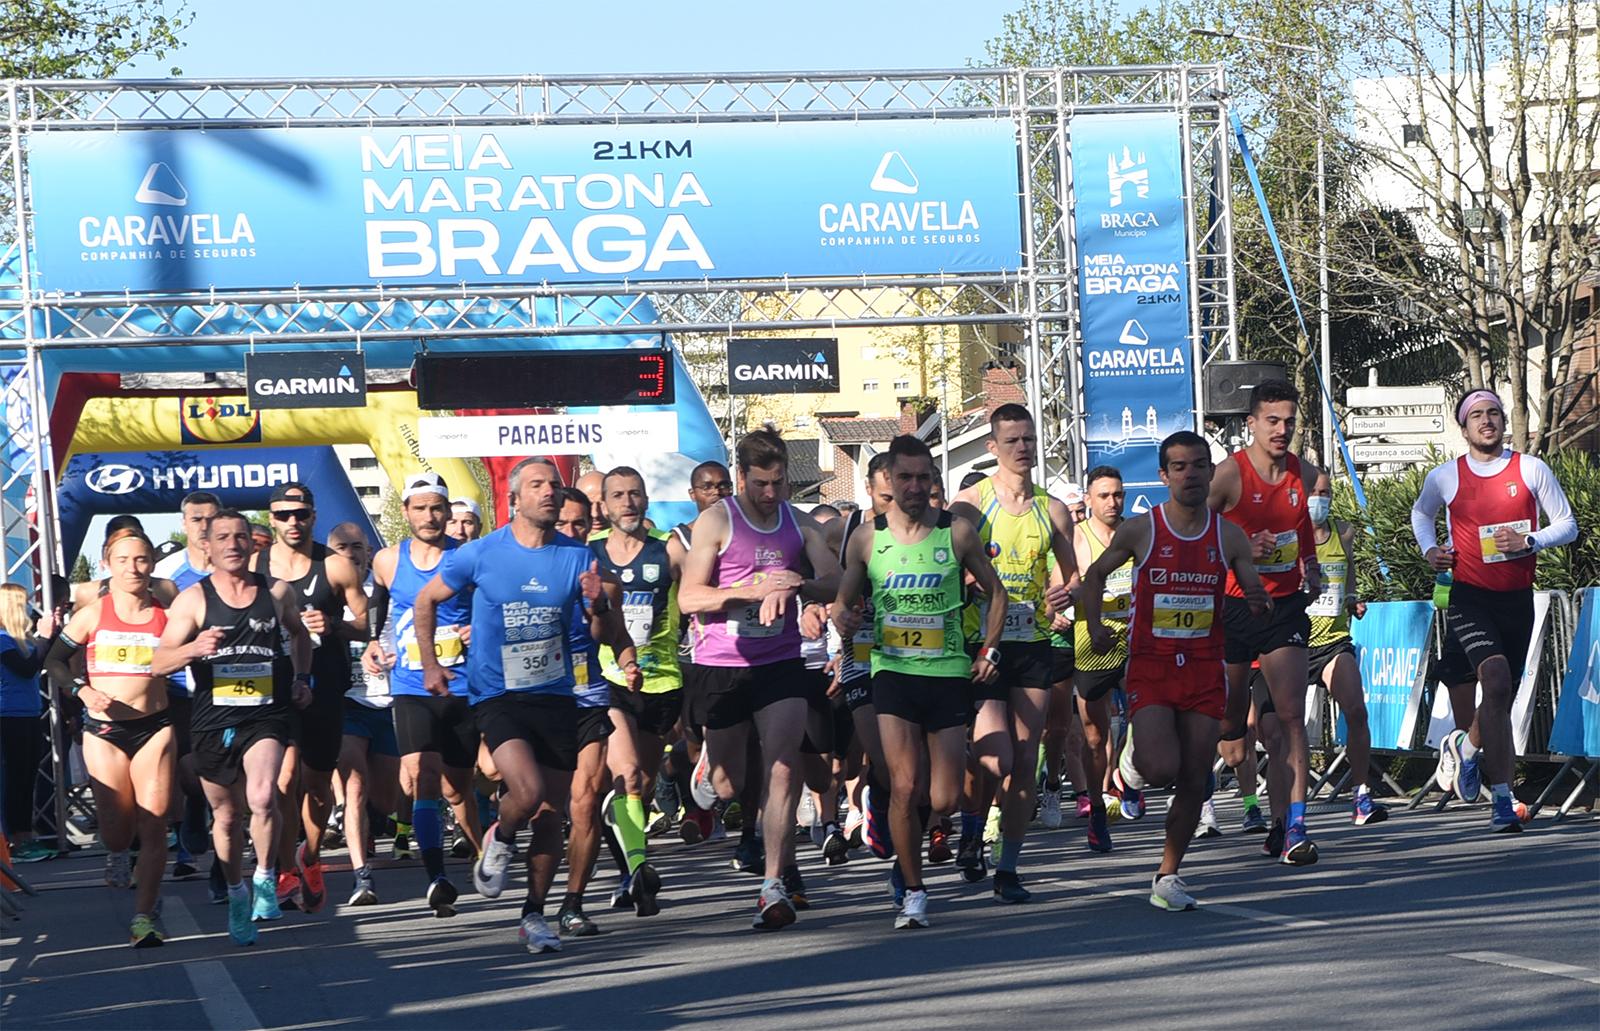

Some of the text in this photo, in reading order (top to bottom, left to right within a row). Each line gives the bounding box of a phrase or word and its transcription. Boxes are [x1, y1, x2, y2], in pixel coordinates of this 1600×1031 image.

[360, 133, 513, 171] MEIA
[593, 140, 692, 160] 21KM
[363, 172, 712, 213] MARATONA
[819, 200, 980, 233] CARAVELA
[1100, 212, 1159, 228] BRAGA
[78, 213, 256, 248] CARAVELA
[365, 213, 715, 278] BRAGA
[820, 233, 981, 247] COMPANHIA DE SEGUROS
[80, 248, 257, 262] COMPANHIA DE SEGUROS
[1084, 254, 1125, 266] MEIA
[1085, 263, 1179, 278] MARATONA
[1085, 275, 1180, 295] BRAGA
[1137, 294, 1181, 304] 21KM
[1088, 348, 1185, 370] CARAVELA
[638, 355, 665, 398] 3
[1089, 369, 1134, 378] COMPANHIA
[1150, 367, 1185, 376] SEGUROS
[499, 418, 603, 446] PARABÉNS
[1354, 420, 1386, 429] tribunal
[1355, 448, 1424, 458] segurança social
[152, 463, 299, 490] HYUNDAI
[1170, 571, 1219, 585] navarra
[898, 592, 946, 605] PREVENT
[504, 614, 561, 628] BRAGA
[745, 608, 760, 621] 34
[898, 616, 936, 625] CARAVELA
[1173, 612, 1194, 628] 10
[901, 631, 923, 647] 12
[118, 648, 127, 662] 9
[522, 654, 549, 670] 350
[1371, 648, 1421, 687] CARAVEL
[233, 680, 256, 695] 46
